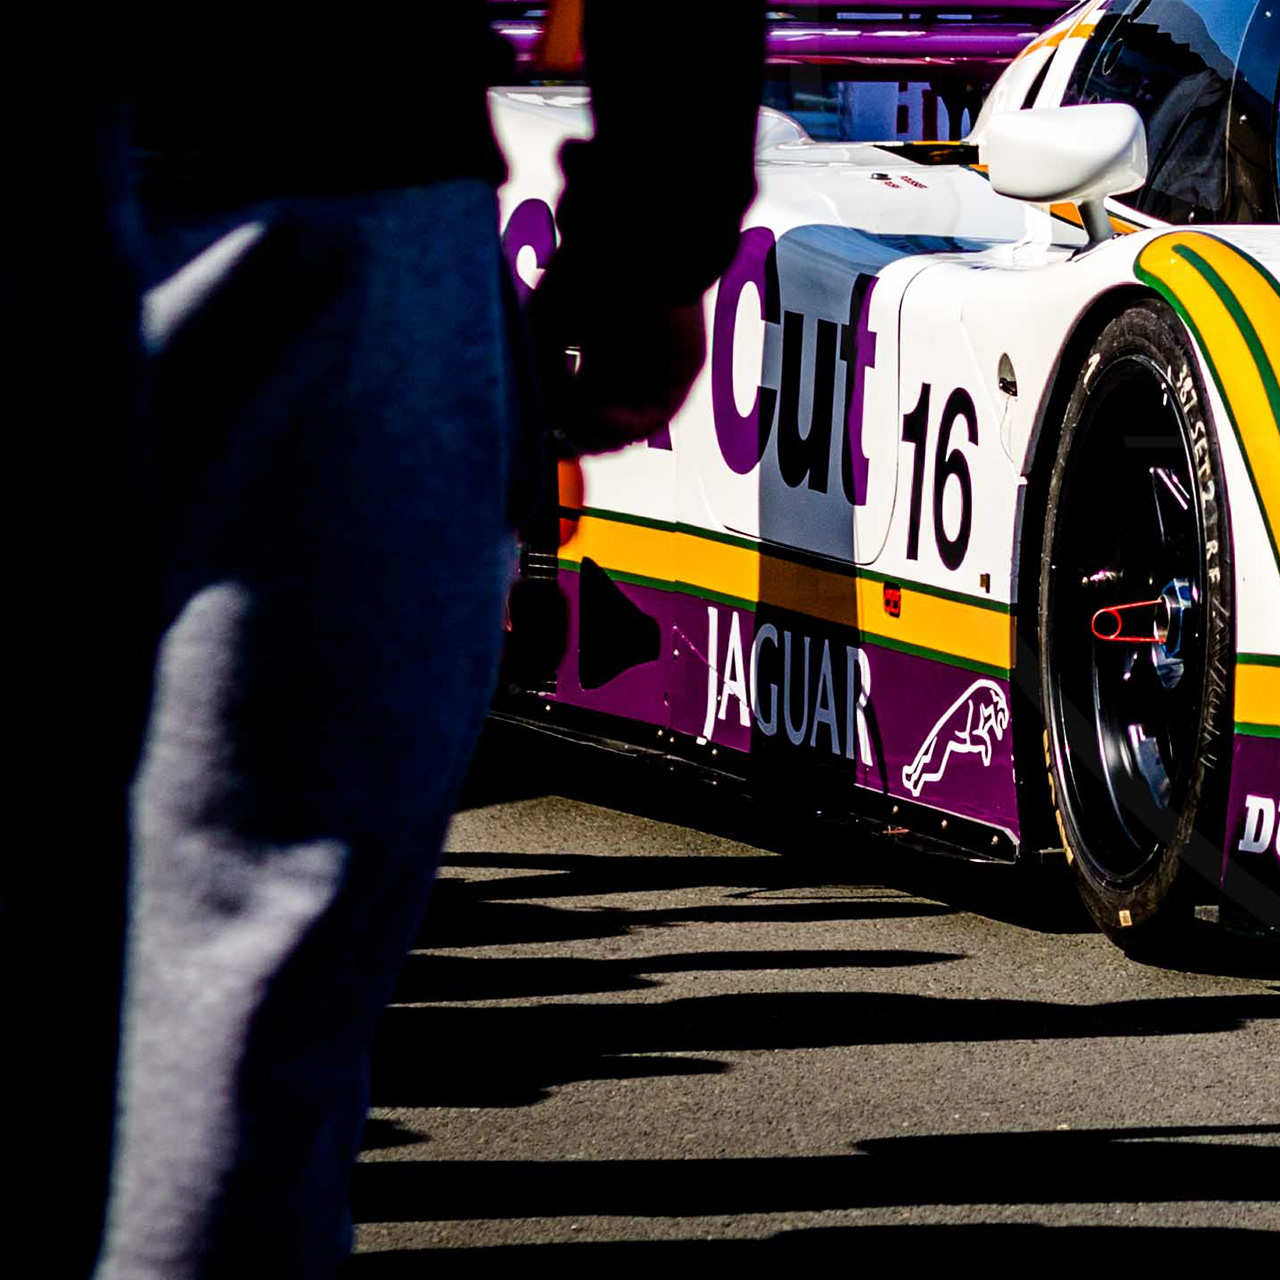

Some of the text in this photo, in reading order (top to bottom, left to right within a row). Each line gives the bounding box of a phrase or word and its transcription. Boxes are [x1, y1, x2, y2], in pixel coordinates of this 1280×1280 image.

[711, 225, 879, 507] Cut
[901, 382, 979, 572] 16
[697, 606, 874, 767] JAGUAR
